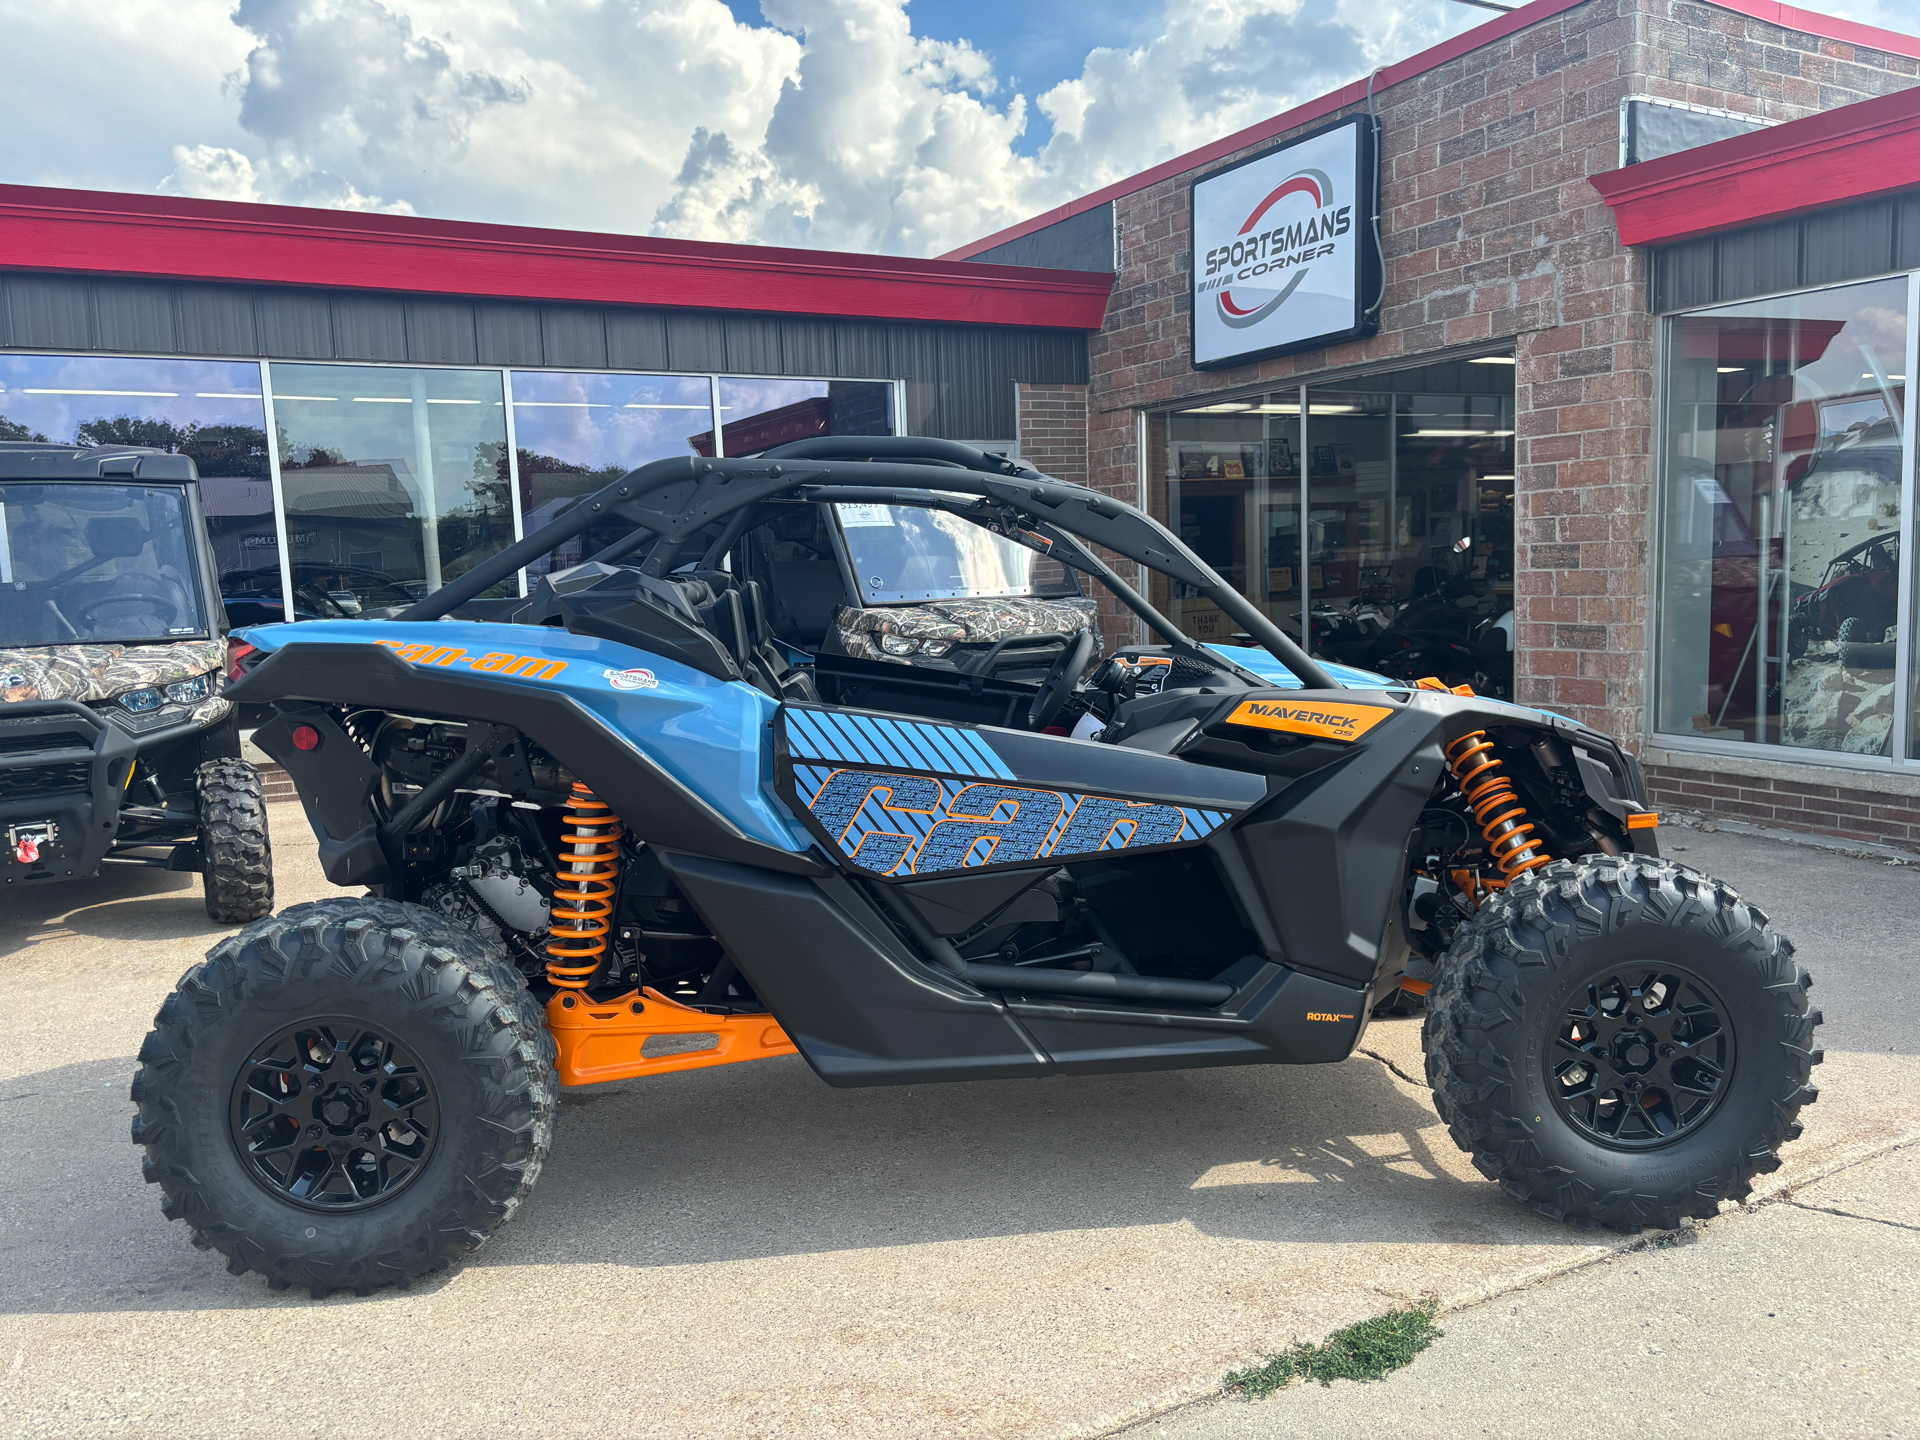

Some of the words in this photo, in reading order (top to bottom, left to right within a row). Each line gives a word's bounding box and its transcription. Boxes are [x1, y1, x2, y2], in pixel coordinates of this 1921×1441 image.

[1205, 205, 1351, 276] SPORTSMANS
[1237, 242, 1336, 281] CORNER
[1192, 615, 1219, 625] THANK
[1198, 624, 1214, 634] YOU
[609, 670, 657, 686] SPORTSMANS
[1248, 703, 1359, 729] MAVERICK
[1332, 729, 1354, 737] DS
[1306, 1012, 1340, 1022] ROTAX
